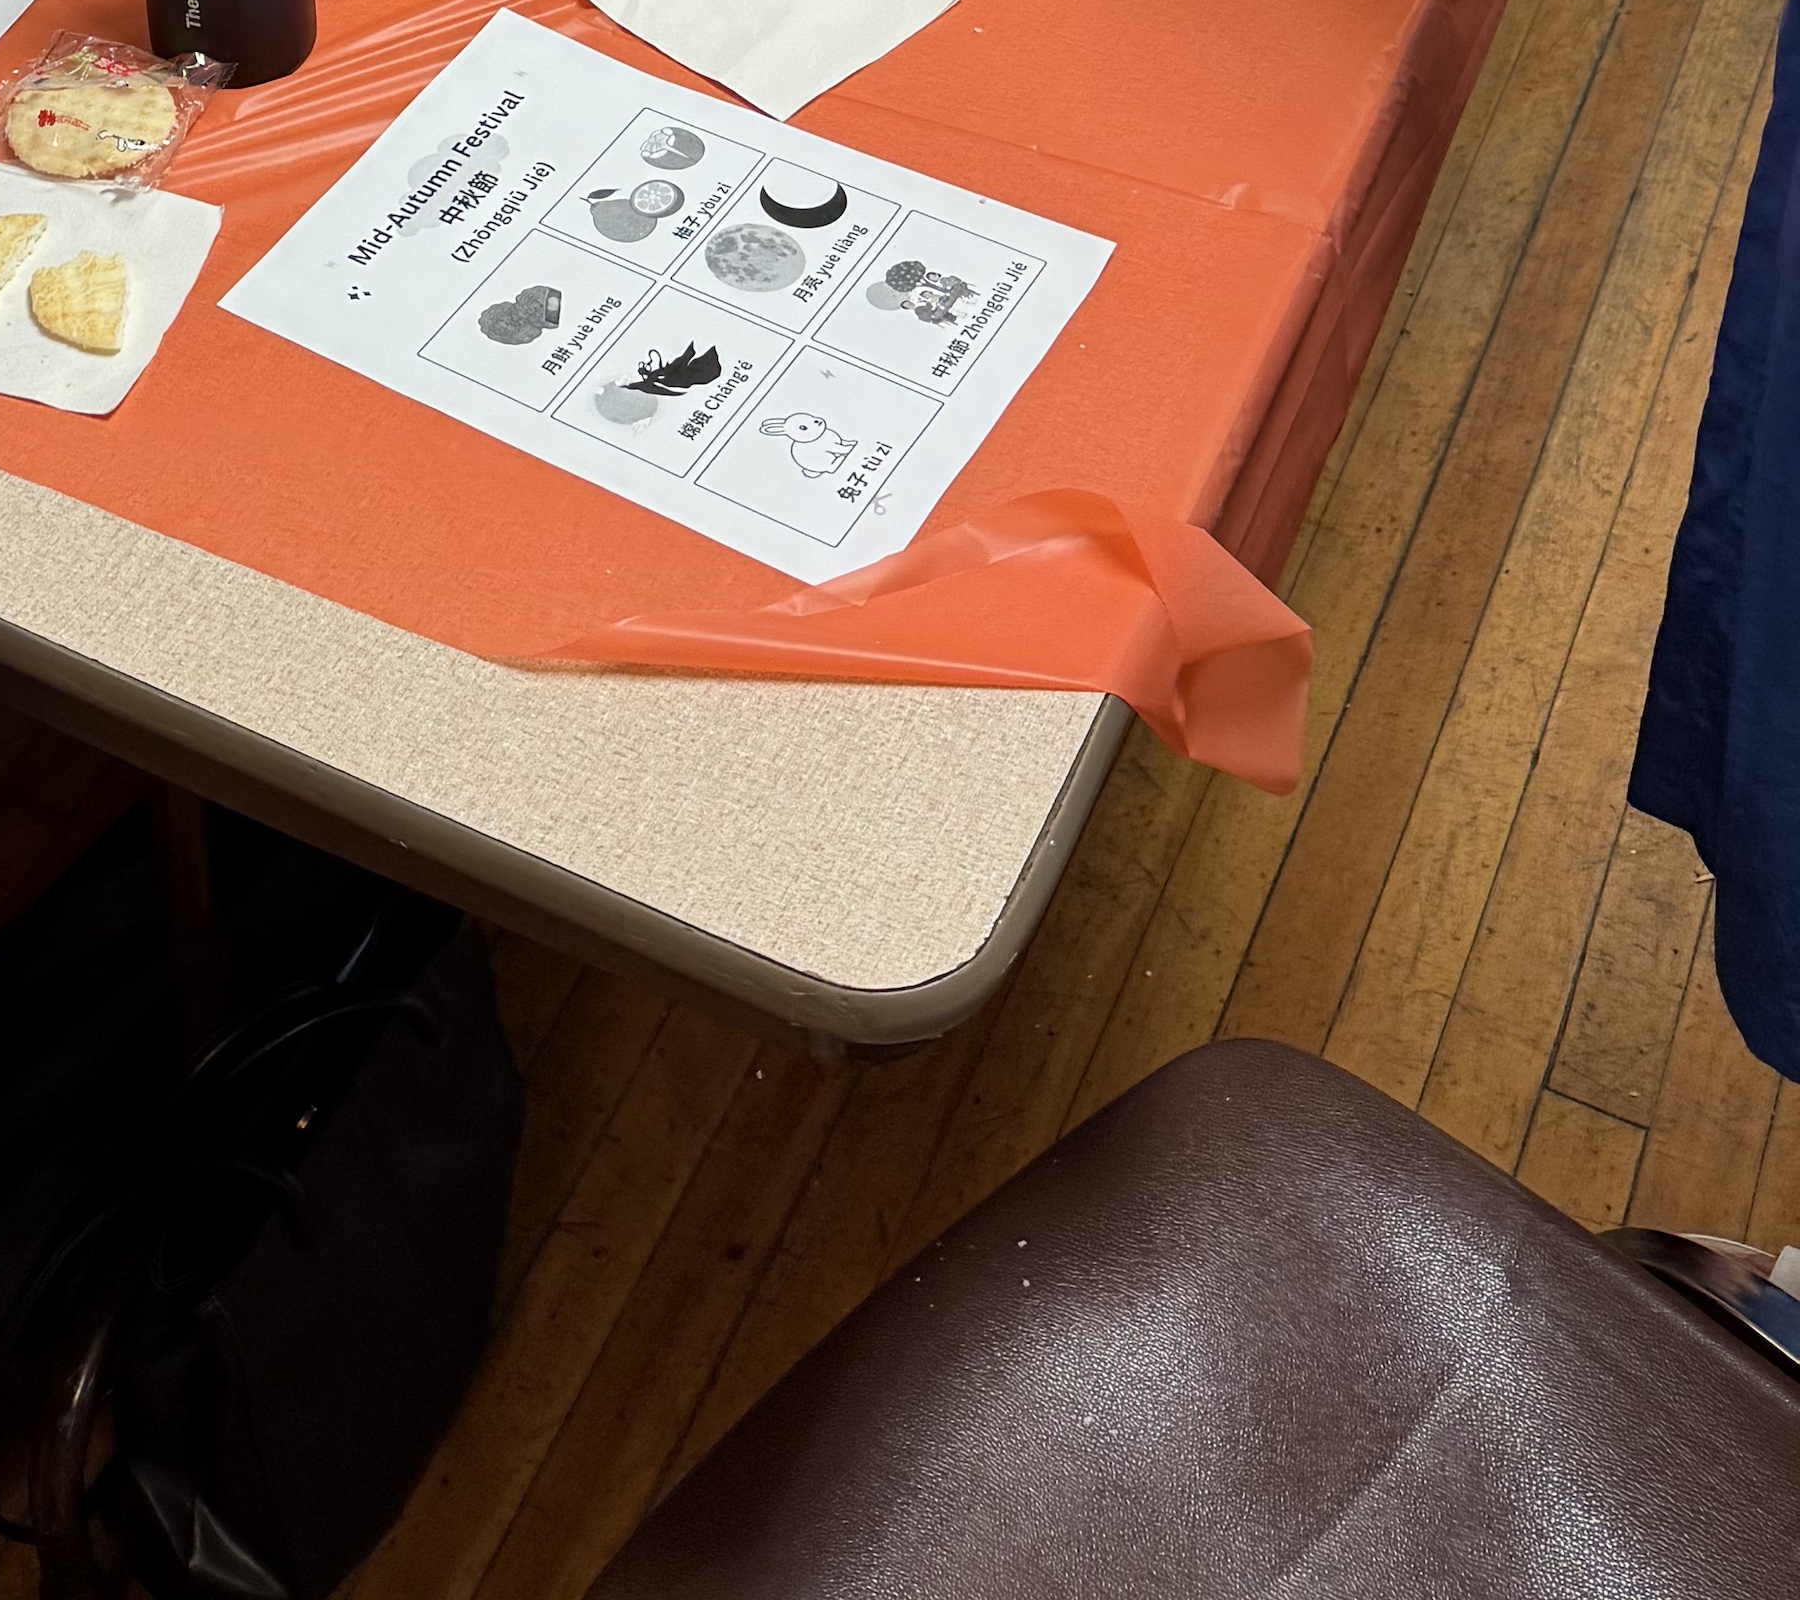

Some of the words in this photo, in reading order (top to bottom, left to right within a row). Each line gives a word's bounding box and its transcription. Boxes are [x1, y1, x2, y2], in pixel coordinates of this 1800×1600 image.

[347, 157, 463, 266] Mid-Autumn
[451, 90, 526, 158] Festival
[438, 169, 500, 225] 中秋節
[450, 189, 529, 263] (Zhōngqiū
[522, 161, 557, 191] Jié)
[671, 214, 701, 241] 柚子
[700, 193, 724, 220] yòu
[718, 182, 733, 196] zi
[792, 274, 824, 303] 月亮
[817, 253, 841, 280] yuè
[833, 223, 869, 255] liàng
[541, 346, 573, 376] 月餅
[568, 322, 594, 352] yuè
[931, 338, 970, 380] 中秋節
[960, 280, 1012, 341] Zhōngqiū
[1006, 260, 1028, 283] Jié
[677, 408, 713, 441] 嫦娥
[836, 470, 869, 504] 兔子
[861, 455, 884, 474] tù
[876, 440, 893, 458] zi
